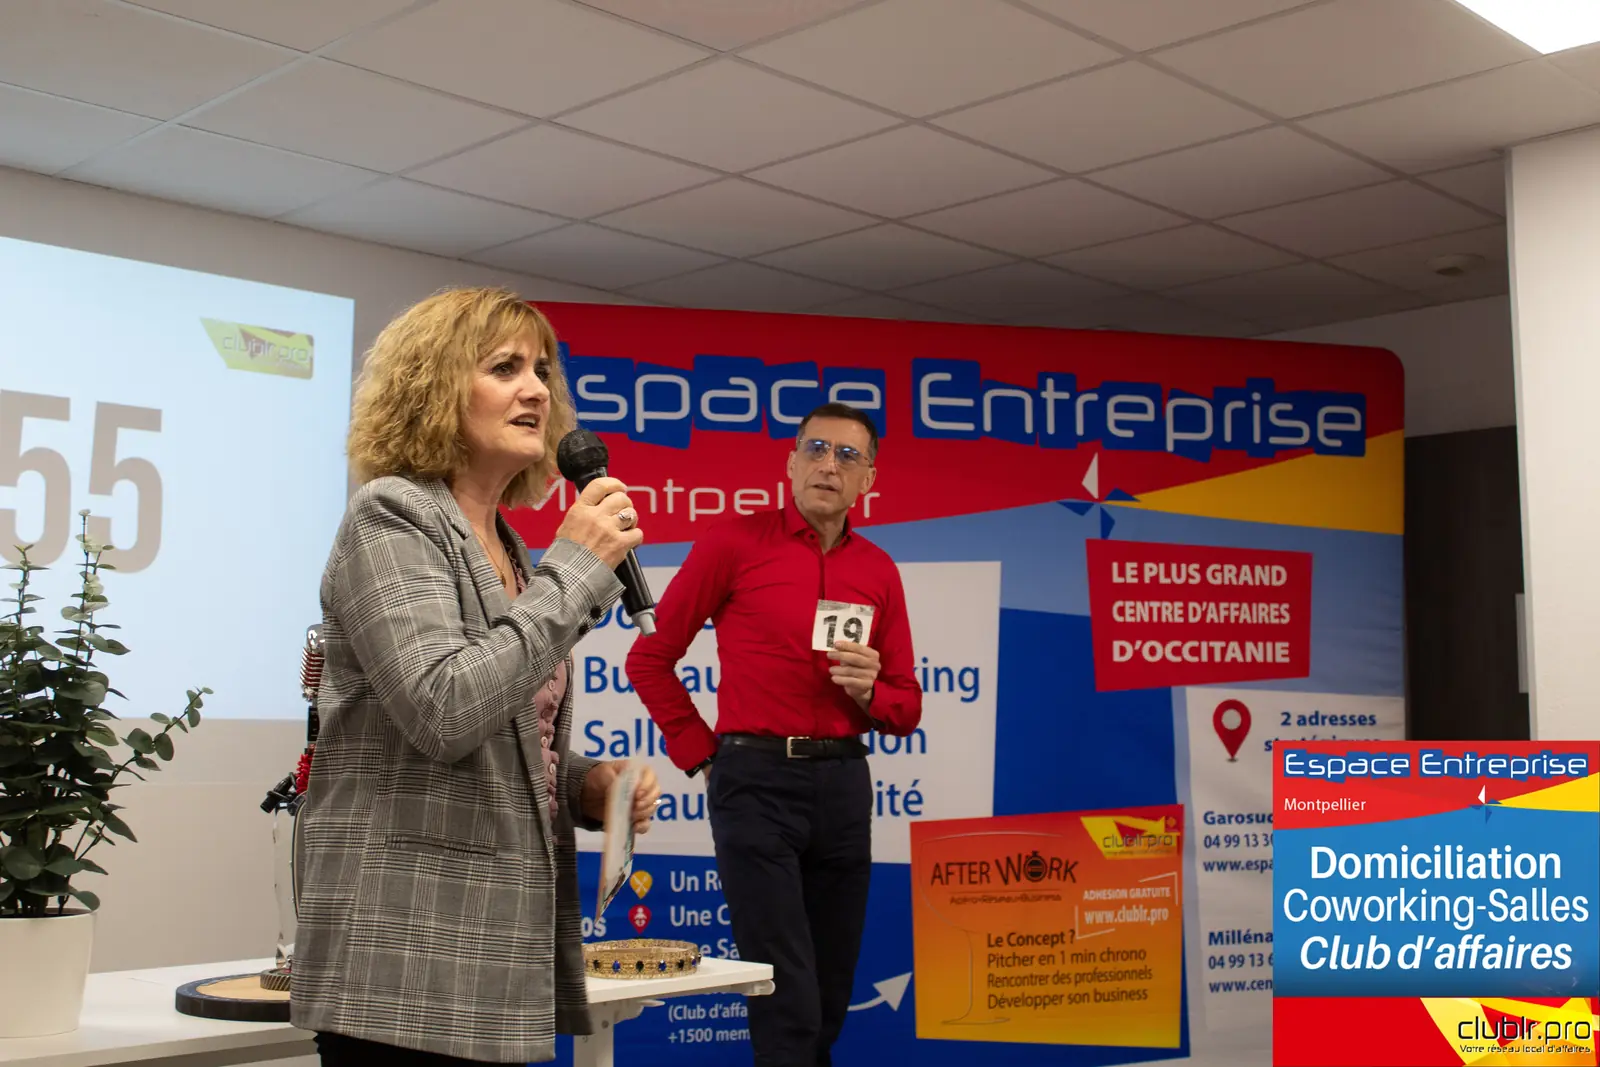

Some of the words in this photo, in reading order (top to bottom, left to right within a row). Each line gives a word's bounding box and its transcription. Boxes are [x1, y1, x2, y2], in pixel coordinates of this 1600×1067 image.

[576, 373, 881, 433] space
[919, 372, 1362, 452] Entreprise
[1112, 562, 1139, 583] LE
[1143, 562, 1201, 585] PLUS
[1206, 564, 1287, 586] GRAND
[1112, 600, 1184, 623] CENTRE
[1188, 601, 1290, 625] D'AFFAIRES
[823, 615, 863, 648] 19
[1112, 640, 1290, 663] D'OCCITANIE
[1280, 711, 1292, 726] 2
[1296, 710, 1377, 726] adresses
[1204, 835, 1221, 849] 04
[1224, 834, 1240, 848] 99
[1244, 834, 1259, 847] 13
[930, 861, 991, 886] AFTER
[995, 850, 1079, 886] WORK
[1203, 858, 1273, 874] www.espa
[670, 870, 699, 892] Un
[1129, 886, 1171, 898] GRATUITE
[670, 905, 712, 926] Une
[1084, 904, 1169, 926] www.clublr.pro
[987, 933, 1003, 948] Le
[1007, 931, 1066, 947] Concept
[1069, 929, 1076, 944] ?
[1208, 928, 1273, 946] Milléna
[987, 952, 1035, 969] Pitcher
[1038, 953, 1056, 966] en
[1060, 951, 1067, 964] 1
[1070, 949, 1096, 964] min
[1100, 947, 1147, 963] chrono
[1208, 955, 1226, 970] 04
[1229, 954, 1245, 968] 99
[1249, 953, 1264, 967] 13
[987, 972, 1050, 989] Rencontrer
[1052, 970, 1072, 986] des
[1074, 965, 1153, 987] professionnels
[988, 993, 1065, 1011] Développer
[1067, 992, 1090, 1004] son
[1093, 987, 1149, 1003] business
[668, 1005, 706, 1023] (Club
[709, 1003, 748, 1018] d'affa
[668, 1027, 713, 1044] +1500
